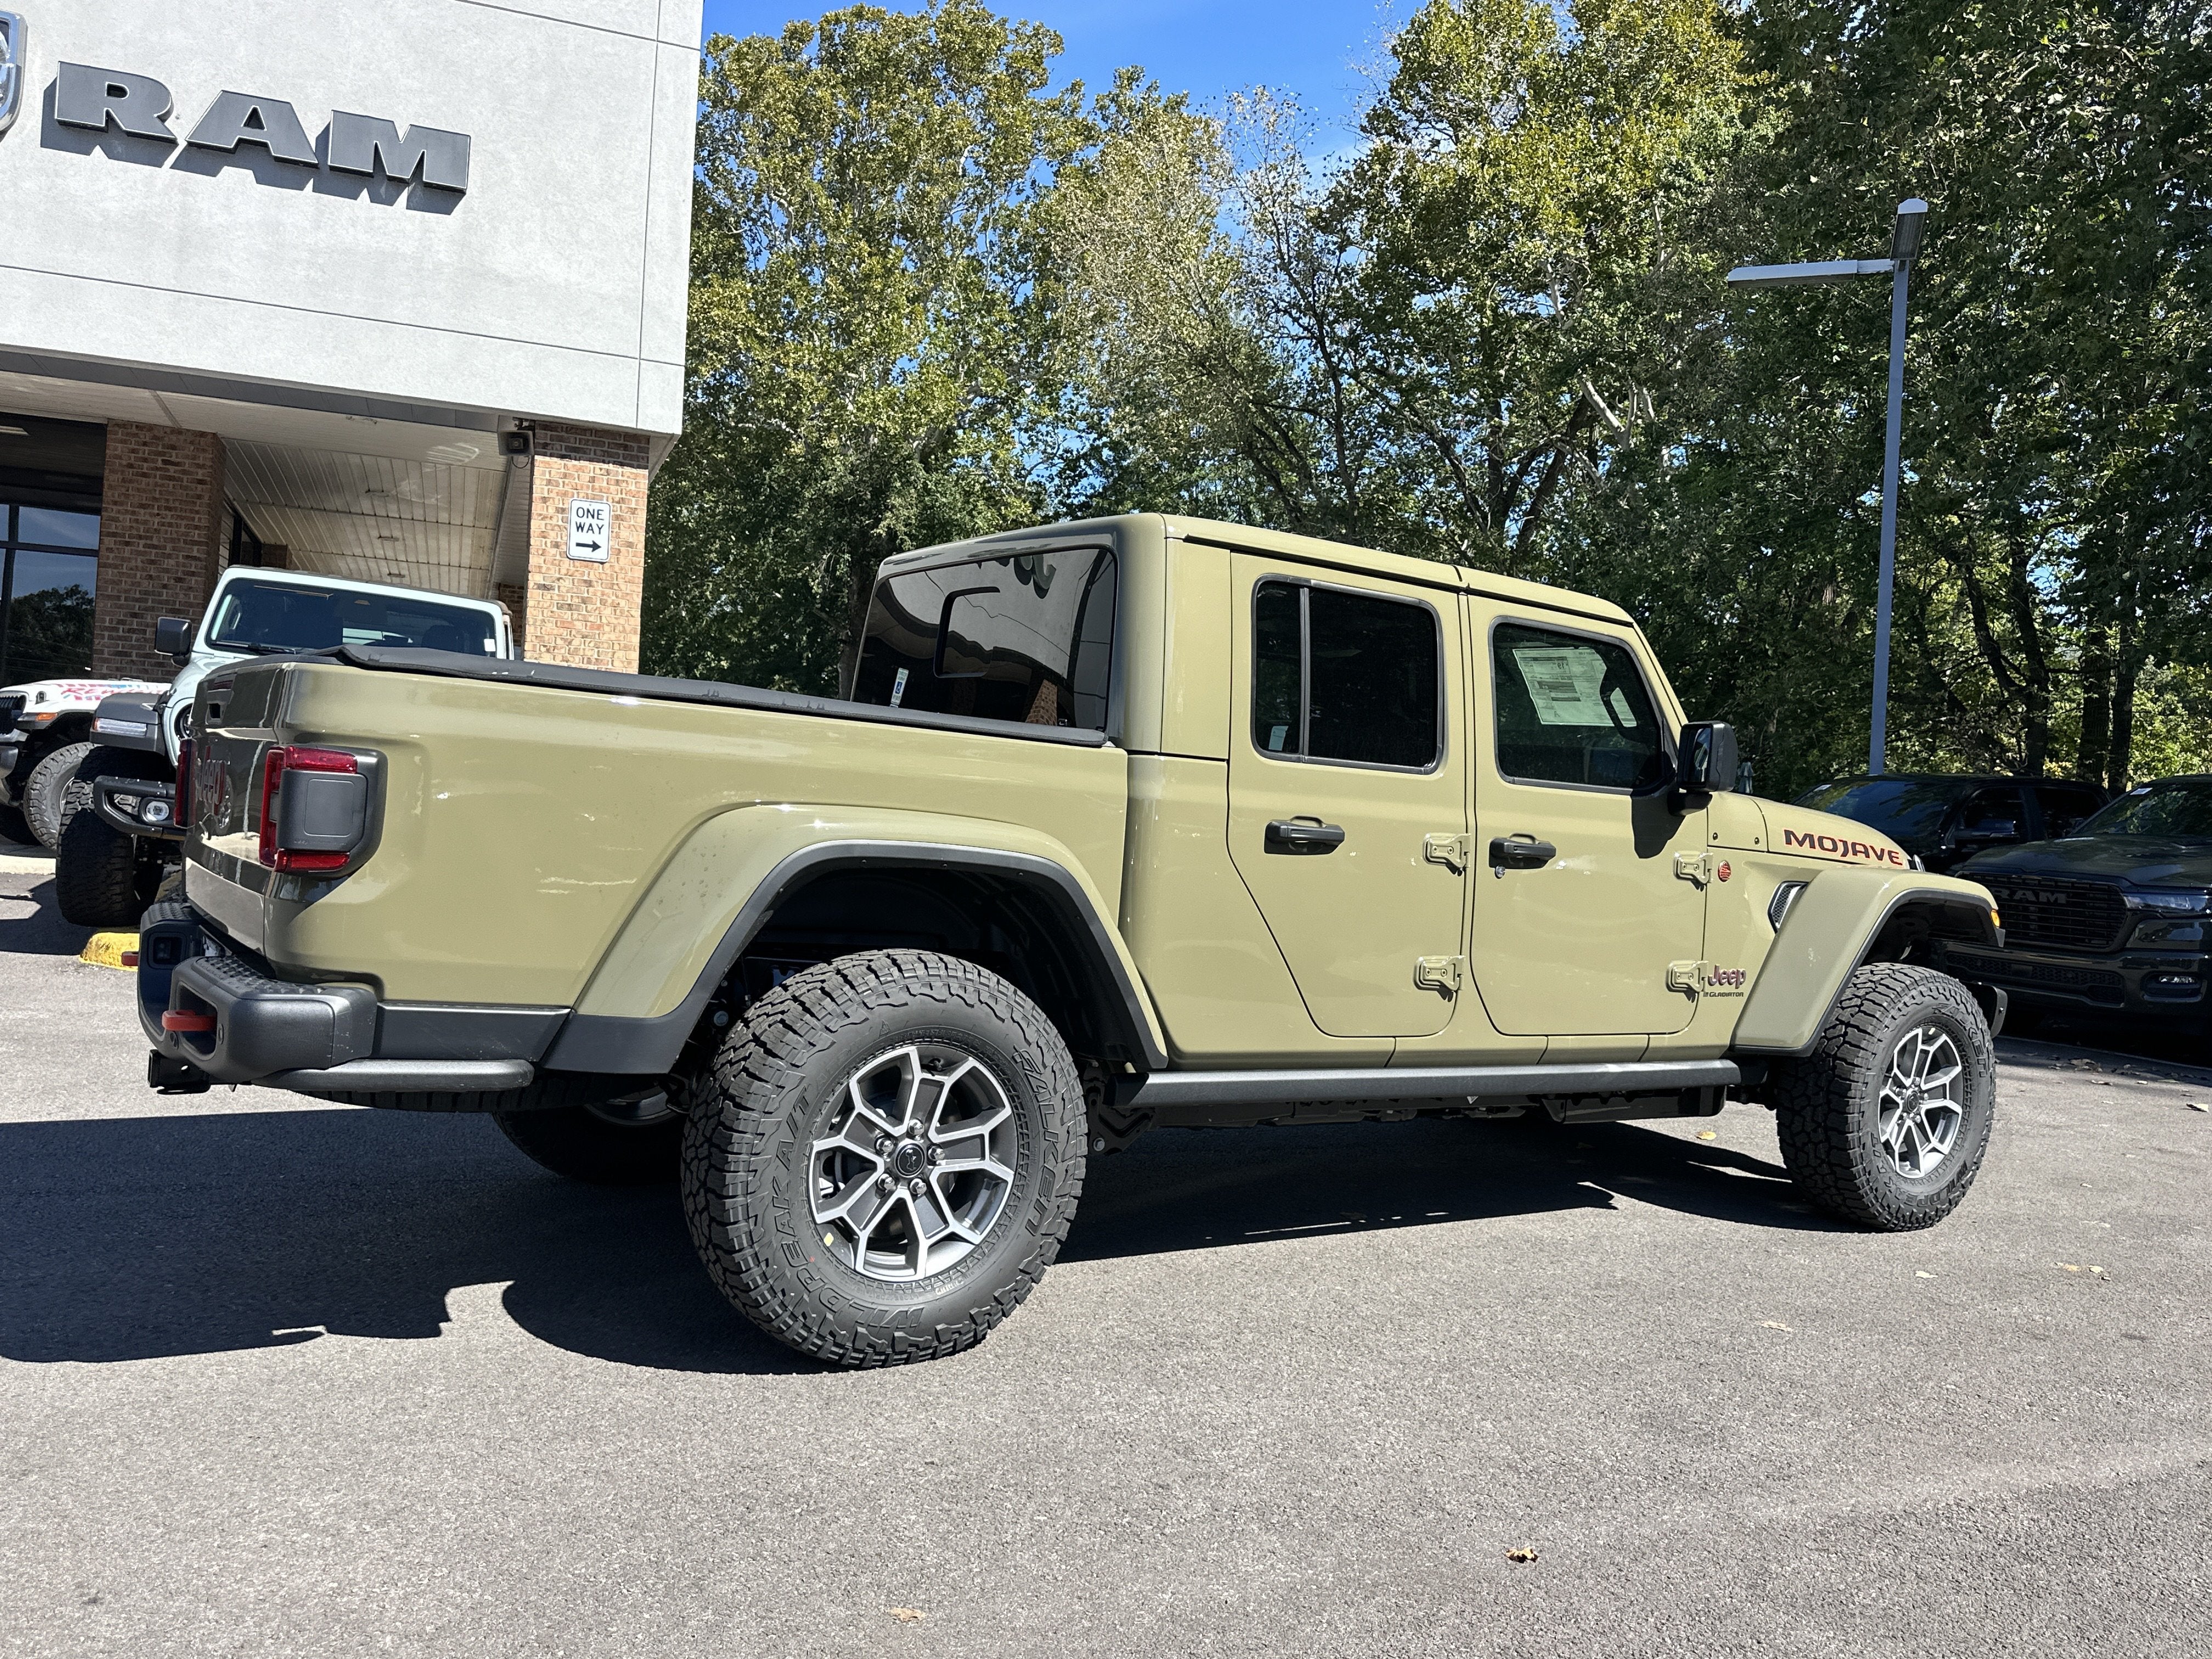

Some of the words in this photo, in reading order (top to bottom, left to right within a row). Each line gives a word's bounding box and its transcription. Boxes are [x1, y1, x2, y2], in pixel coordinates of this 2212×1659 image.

[55, 60, 471, 194] RAM
[576, 507, 605, 521] ONE
[575, 521, 605, 535] WAY
[1784, 829, 1903, 866] MOJAVE
[1990, 887, 2068, 904] RAM
[1707, 964, 1747, 989] Jeep
[772, 1174, 925, 1328] WILDPEAK
